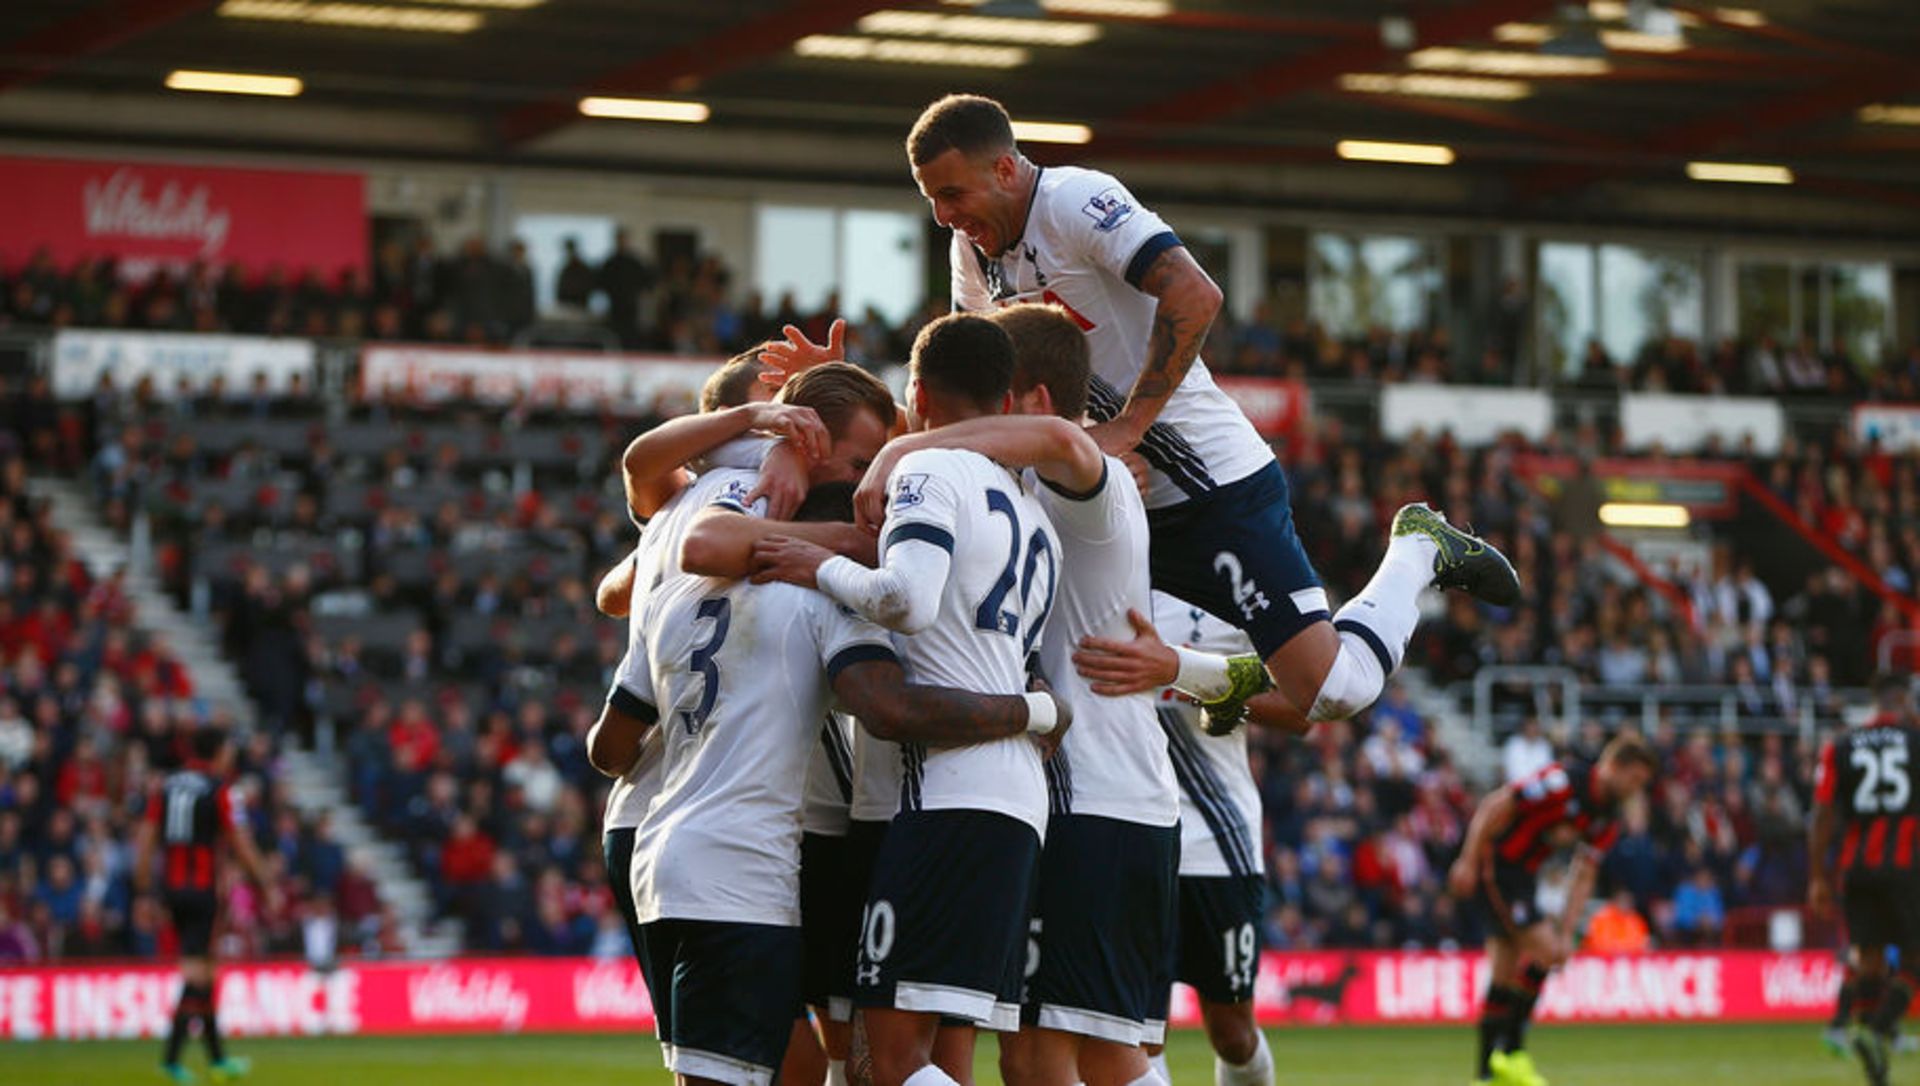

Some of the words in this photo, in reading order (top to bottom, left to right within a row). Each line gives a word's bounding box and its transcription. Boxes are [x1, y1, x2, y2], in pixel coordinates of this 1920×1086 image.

[976, 488, 1055, 657] 20
[1214, 551, 1256, 606] 2
[678, 596, 732, 735] 3
[1850, 748, 1910, 812] 25
[858, 900, 896, 962] 0
[1223, 922, 1257, 976] 19
[1375, 956, 1470, 1019] LIFE
